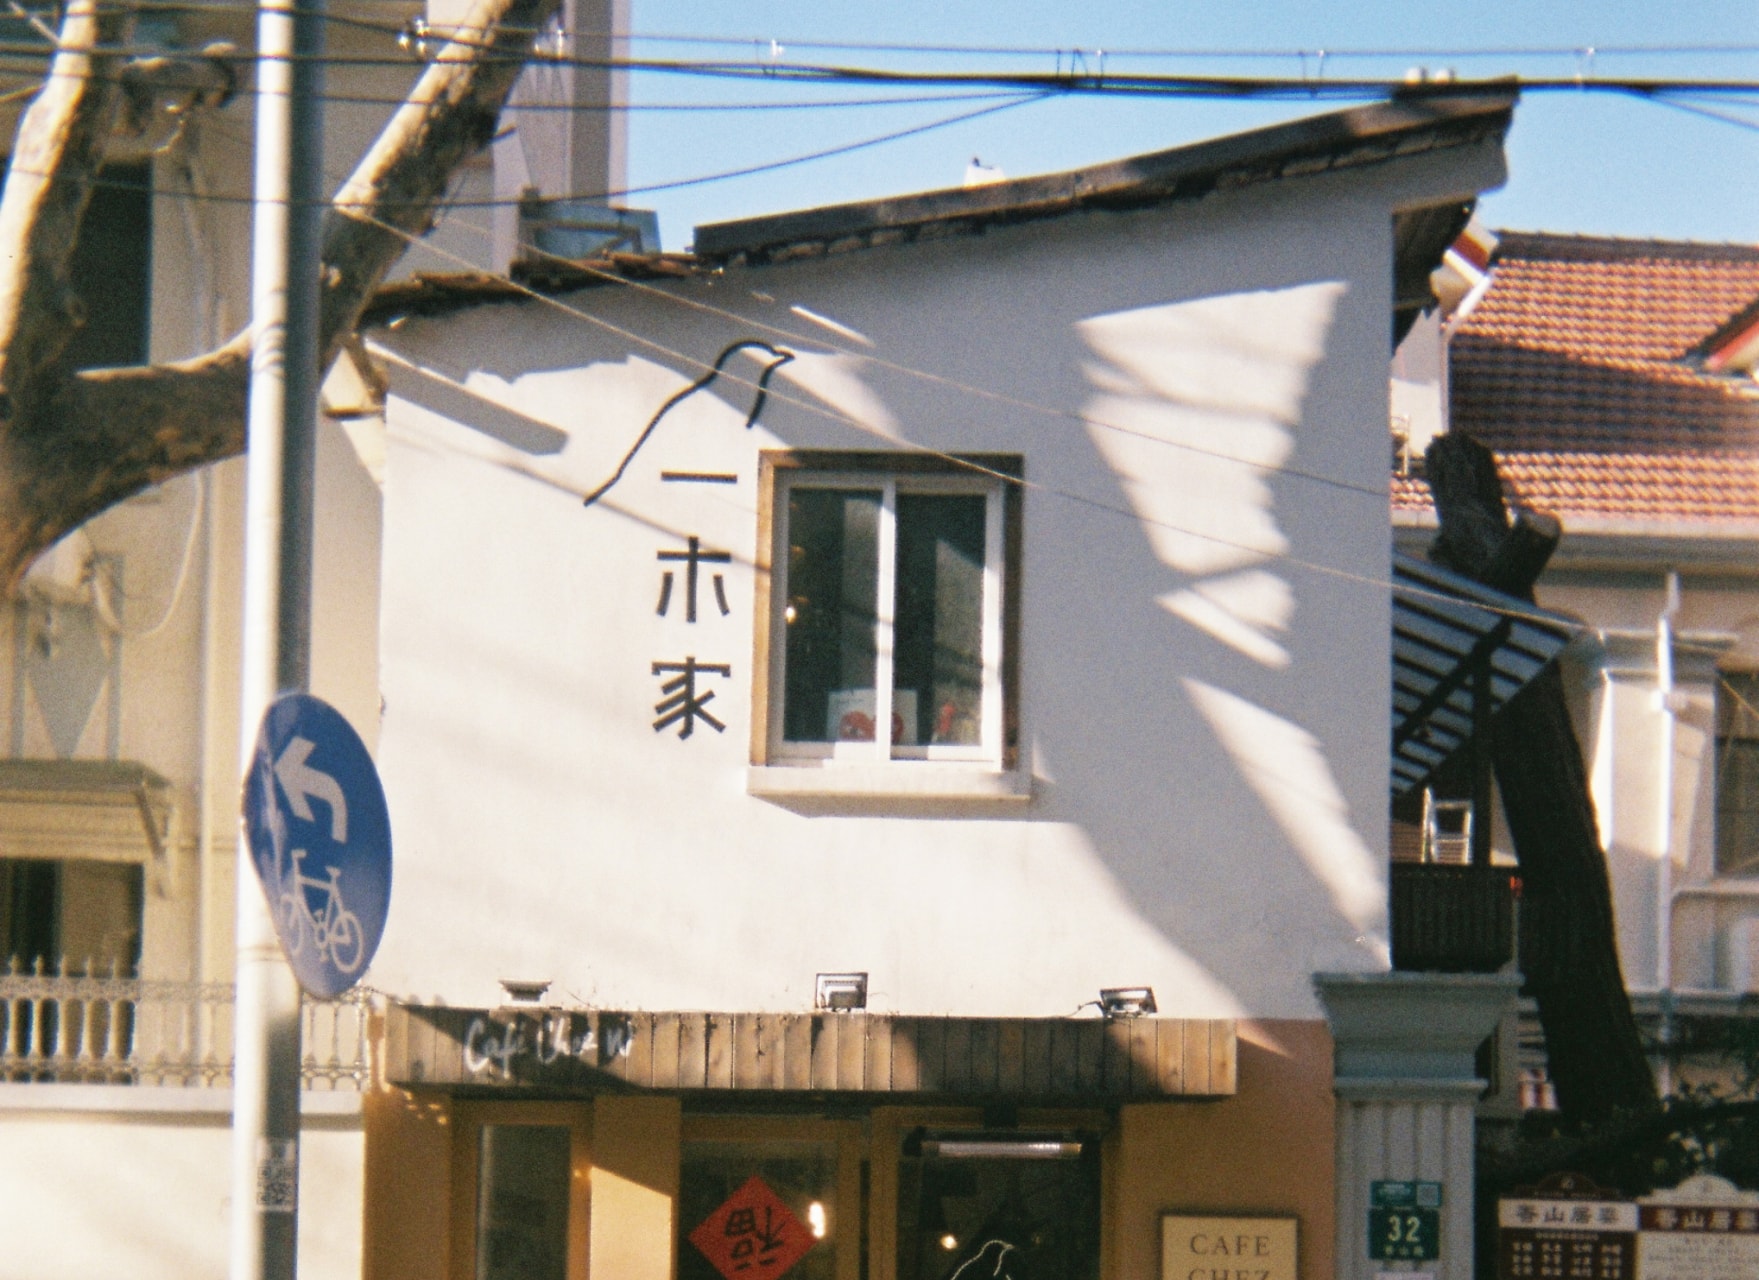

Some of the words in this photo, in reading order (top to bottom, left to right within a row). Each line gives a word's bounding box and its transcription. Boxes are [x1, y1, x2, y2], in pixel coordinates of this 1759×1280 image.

[652, 472, 737, 740] 一木家
[1387, 1215, 1421, 1243] 32
[1190, 1233, 1271, 1257] CAFE
